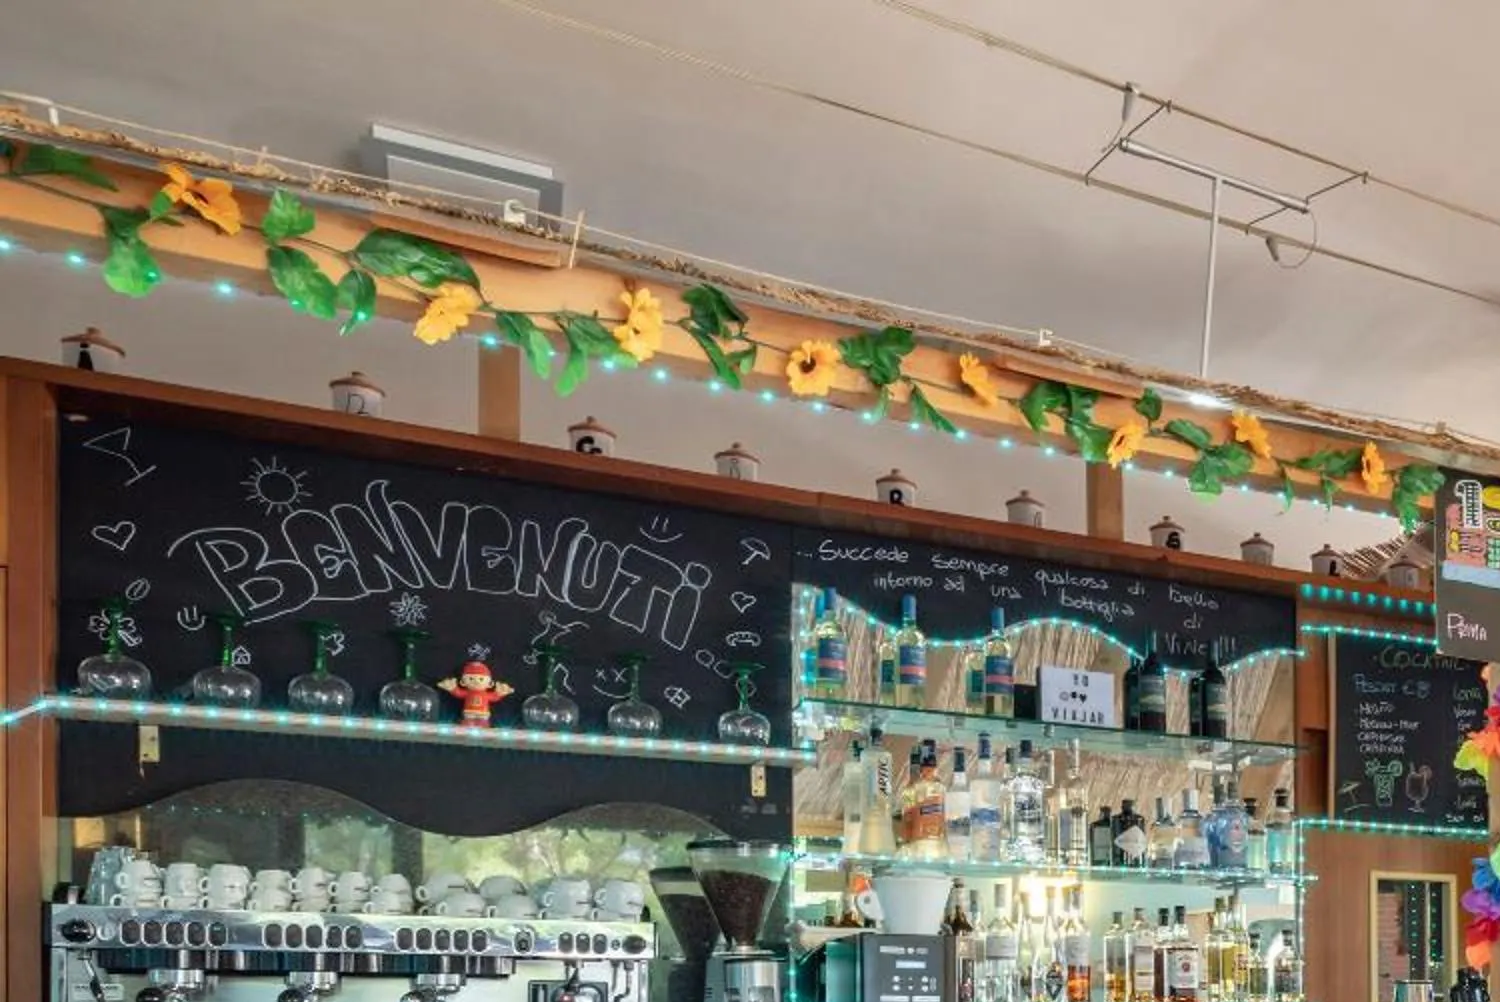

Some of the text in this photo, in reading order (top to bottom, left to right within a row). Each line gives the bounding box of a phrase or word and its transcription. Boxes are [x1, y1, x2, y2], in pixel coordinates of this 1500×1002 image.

[931, 554, 1009, 581] sempre
[1034, 568, 1109, 597] qualcosa
[1127, 581, 1146, 596] di
[873, 571, 934, 591] intorno
[943, 574, 966, 593] ad
[1059, 587, 1136, 624] bottiglia
[1183, 611, 1203, 630] di
[1051, 706, 1105, 725] VIAJAR
[878, 756, 889, 796] ARTIC
